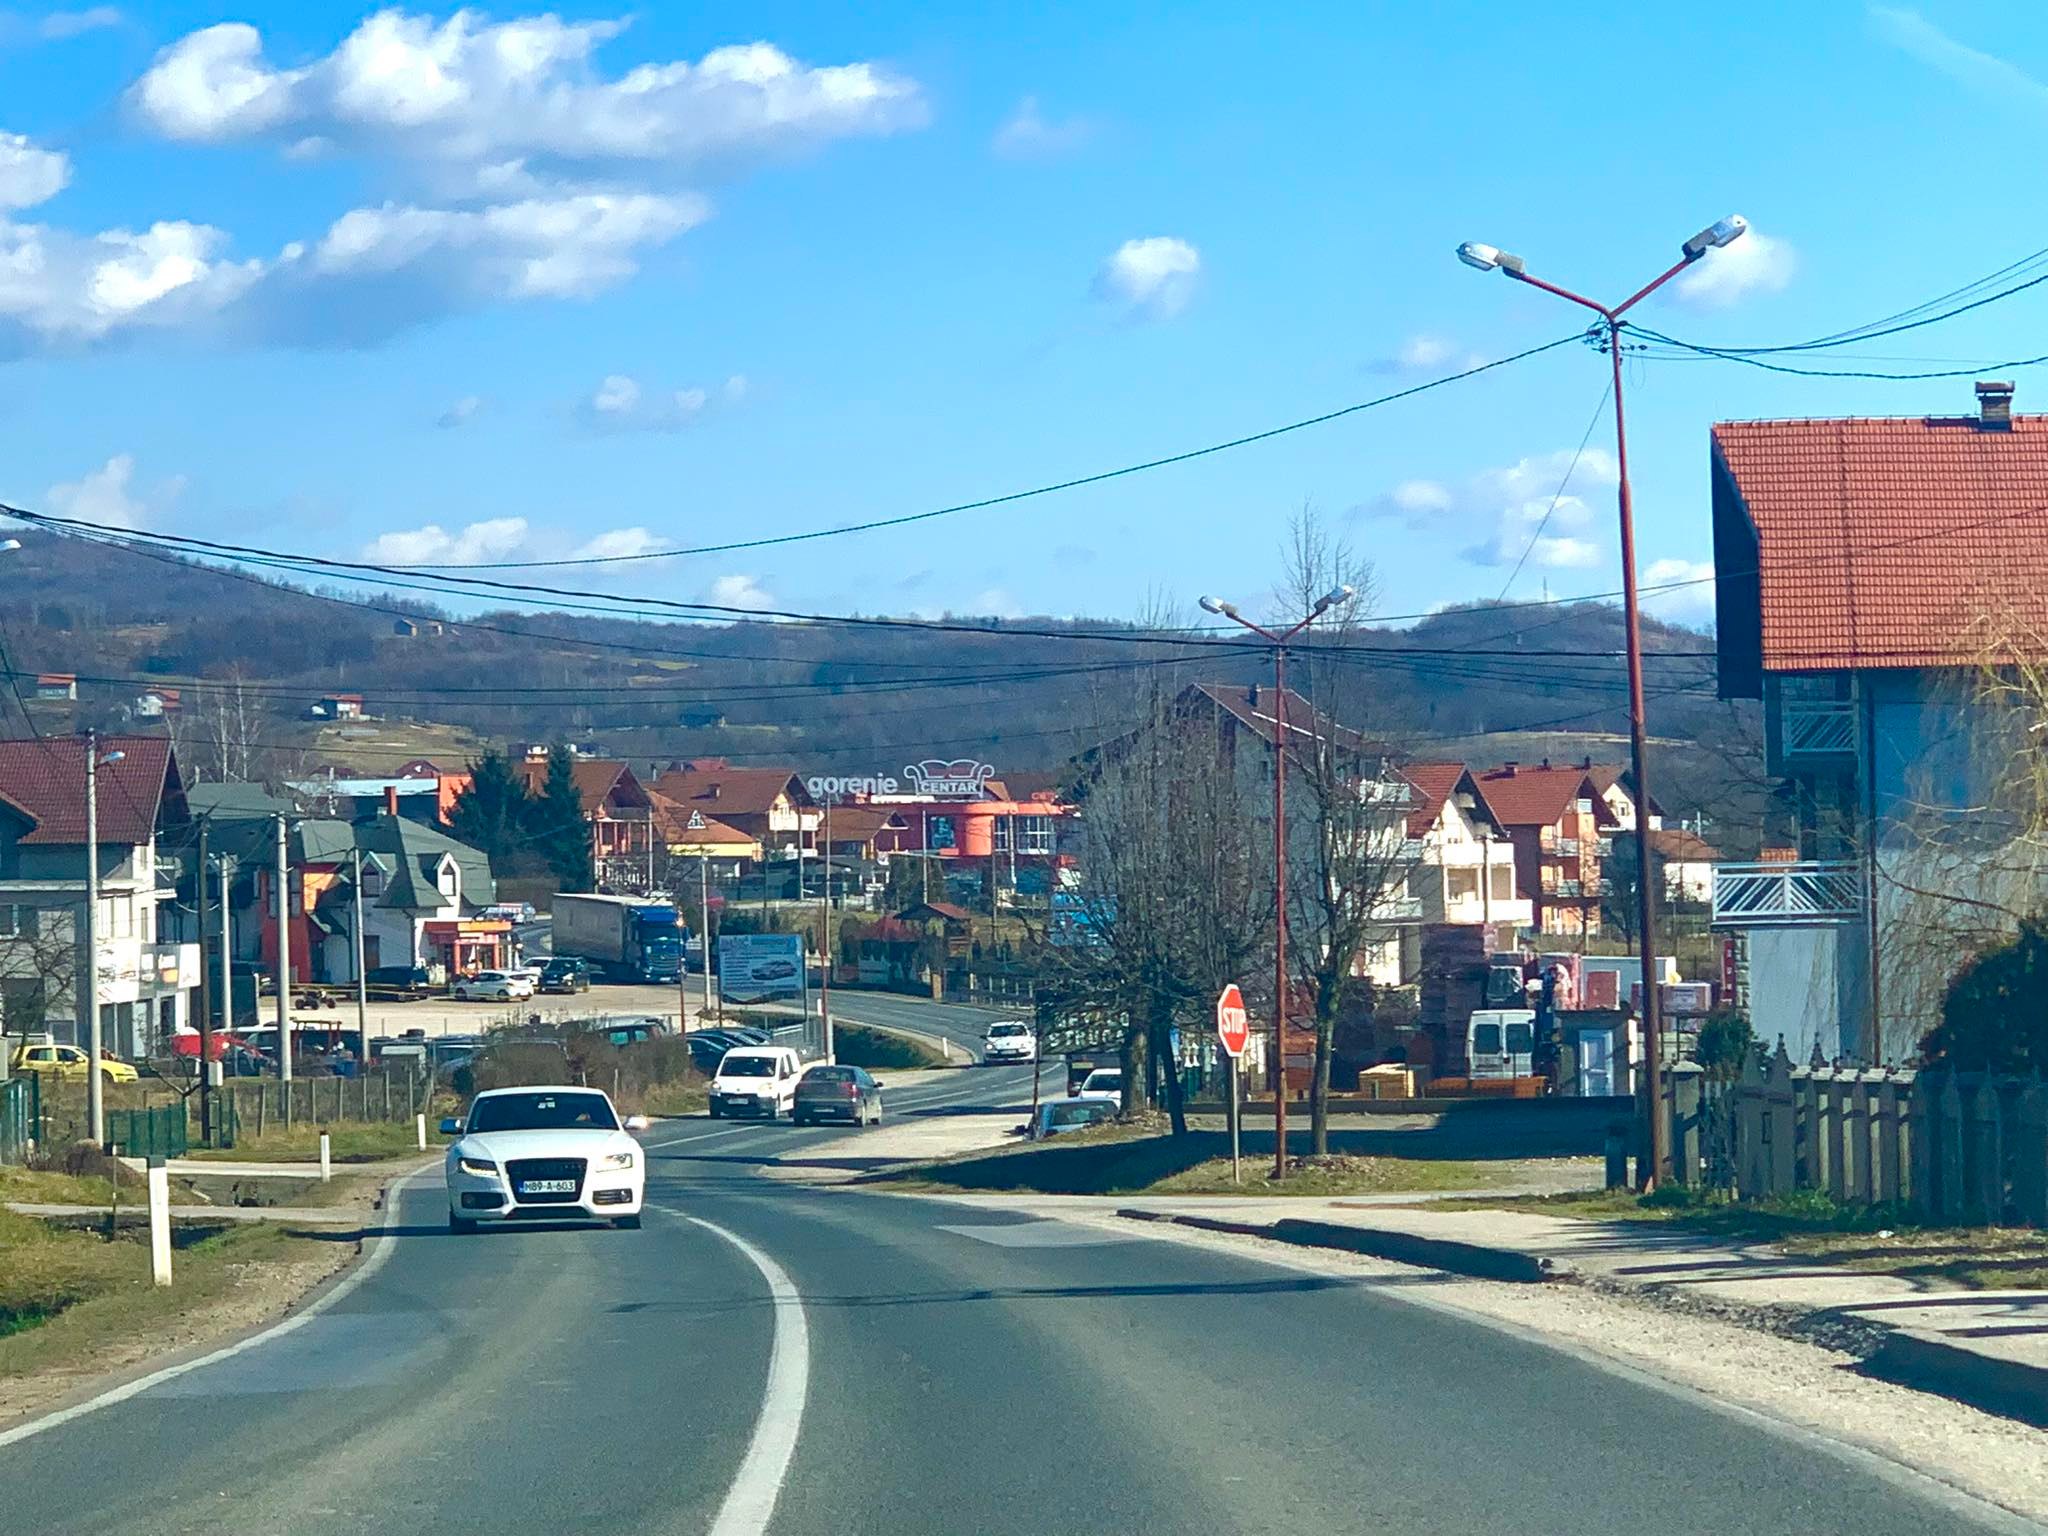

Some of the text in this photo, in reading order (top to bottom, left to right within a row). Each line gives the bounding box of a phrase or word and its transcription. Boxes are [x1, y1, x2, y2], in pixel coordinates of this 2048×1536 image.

[807, 772, 898, 798] gorenje
[921, 781, 979, 792] CENTAR
[1222, 1007, 1247, 1034] STOP
